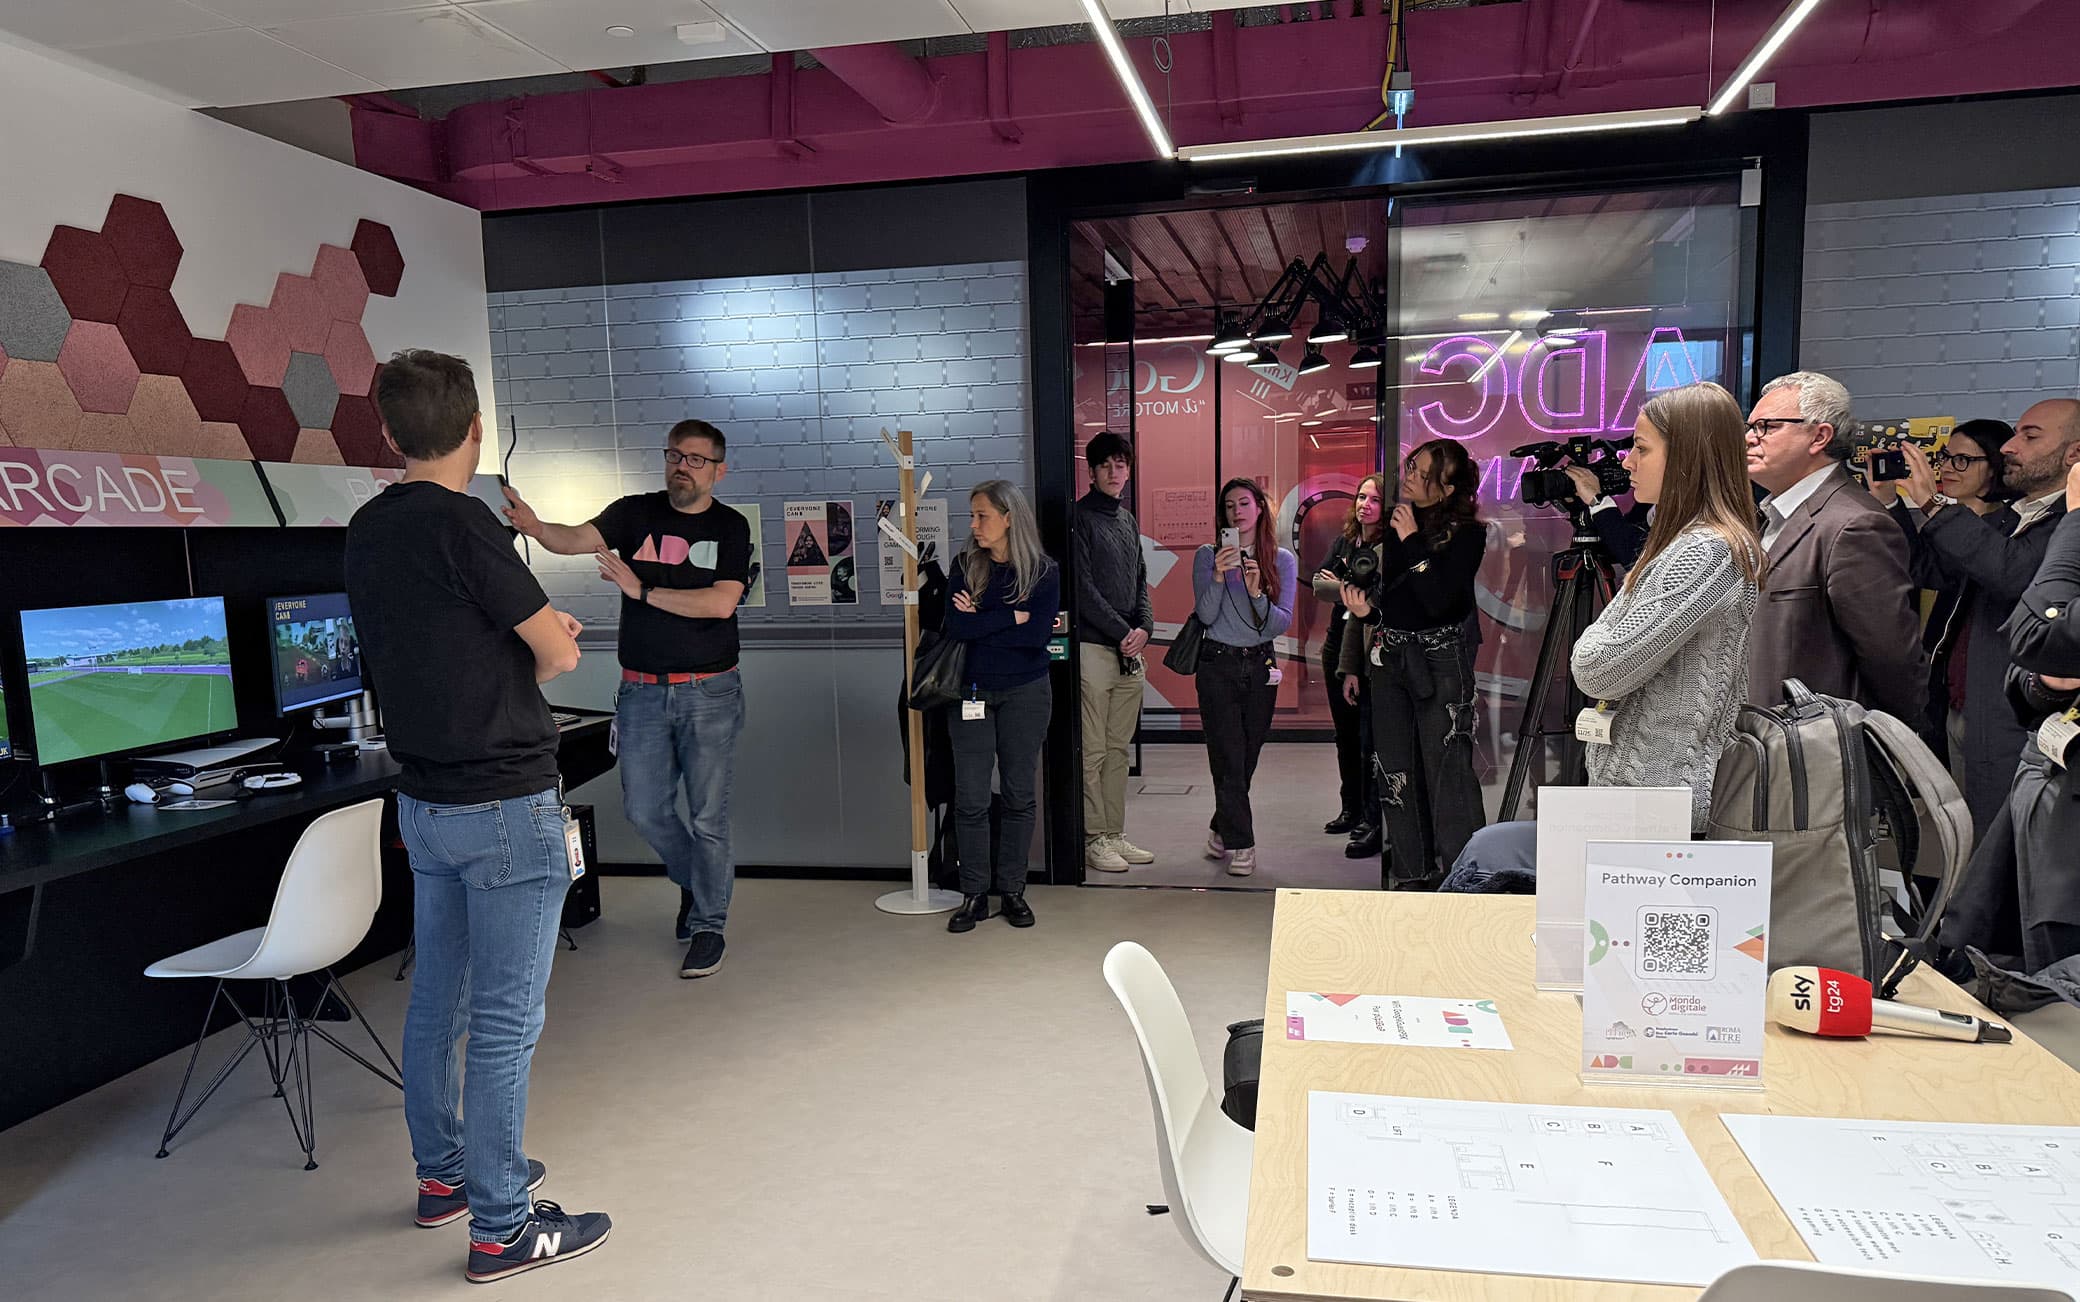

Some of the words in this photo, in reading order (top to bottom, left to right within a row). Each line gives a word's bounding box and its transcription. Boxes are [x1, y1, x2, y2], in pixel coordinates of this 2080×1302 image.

[1602, 873, 1666, 888] Pathway
[1670, 873, 1757, 888] Companion
[1790, 974, 1815, 1011] sky
[1826, 980, 1844, 1013] tg24
[1669, 995, 1701, 1005] Mondo
[1671, 1003, 1707, 1013] digitale
[1721, 1033, 1741, 1041] TRE
[1629, 1124, 1645, 1132] A
[532, 1232, 561, 1258] N
